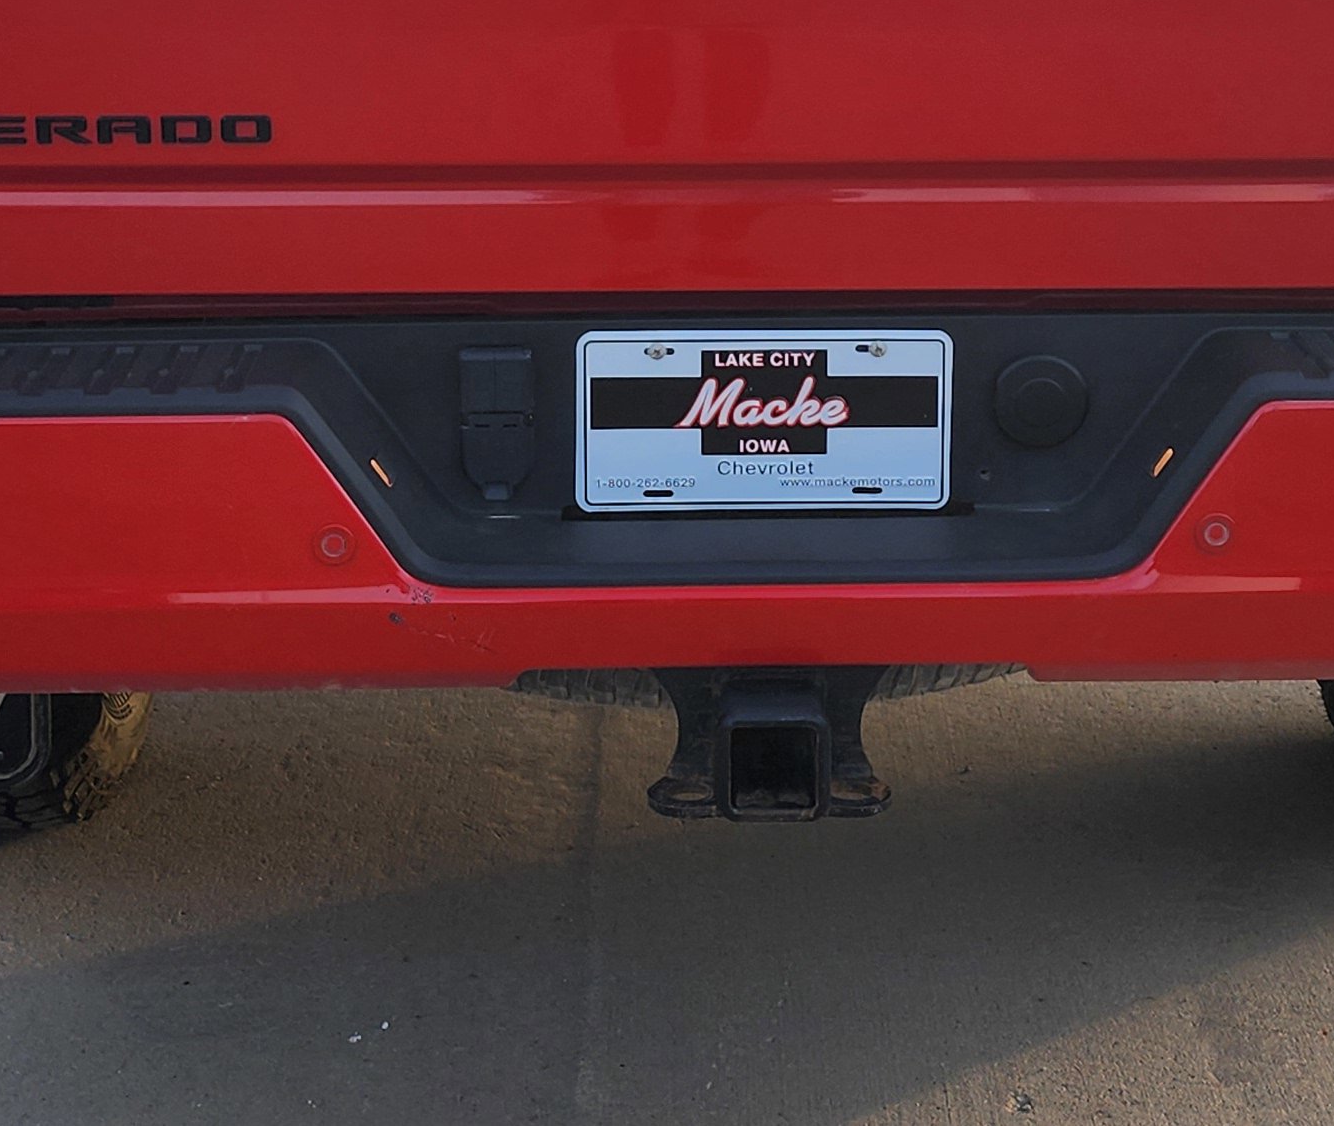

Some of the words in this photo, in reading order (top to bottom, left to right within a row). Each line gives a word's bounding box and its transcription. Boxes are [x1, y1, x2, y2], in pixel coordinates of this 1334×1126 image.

[714, 352, 765, 367] LAKE
[769, 352, 815, 367] CITY
[672, 375, 849, 428] Macke
[739, 439, 790, 453] IOWA
[717, 460, 814, 476] Chevrolet
[596, 478, 696, 488] 1-800-262-6629
[779, 476, 936, 487] www.mackemotors.com
